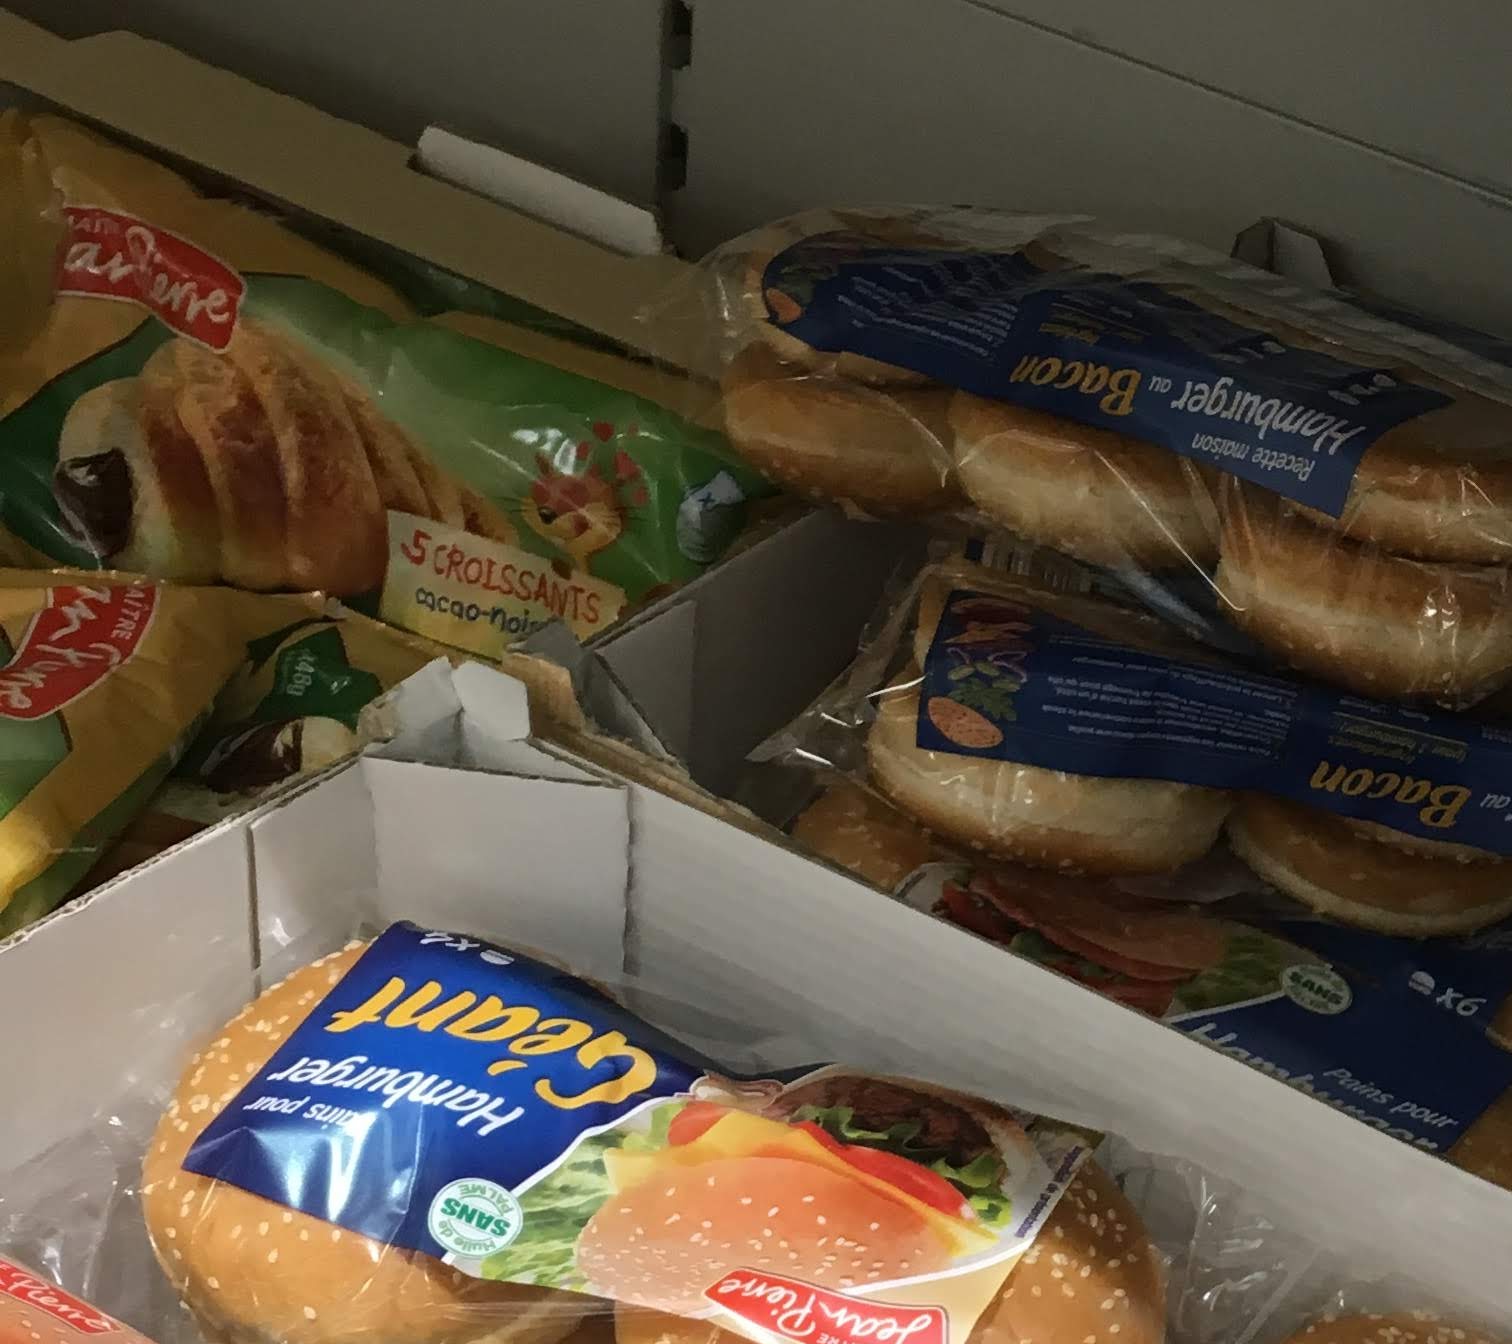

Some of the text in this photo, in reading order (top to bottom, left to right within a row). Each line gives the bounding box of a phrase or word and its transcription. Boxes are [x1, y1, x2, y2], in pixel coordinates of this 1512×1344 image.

[1008, 351, 1367, 459] Hamburger au Bacon
[1191, 432, 1315, 481] Recette maison
[396, 526, 607, 626] 5 CROISSANTS
[112, 588, 155, 644] AÎTRE
[1304, 753, 1473, 834] Bacon
[1479, 789, 1511, 811] au
[1436, 981, 1490, 1019] x6
[325, 975, 660, 1112] Géant
[243, 1093, 300, 1123] pour
[266, 1053, 524, 1140] Hamburger
[1321, 1067, 1459, 1135] Pains pour
[440, 1197, 512, 1237] SANS
[452, 1235, 496, 1253] Huile
[715, 1273, 837, 1341] Pierre
